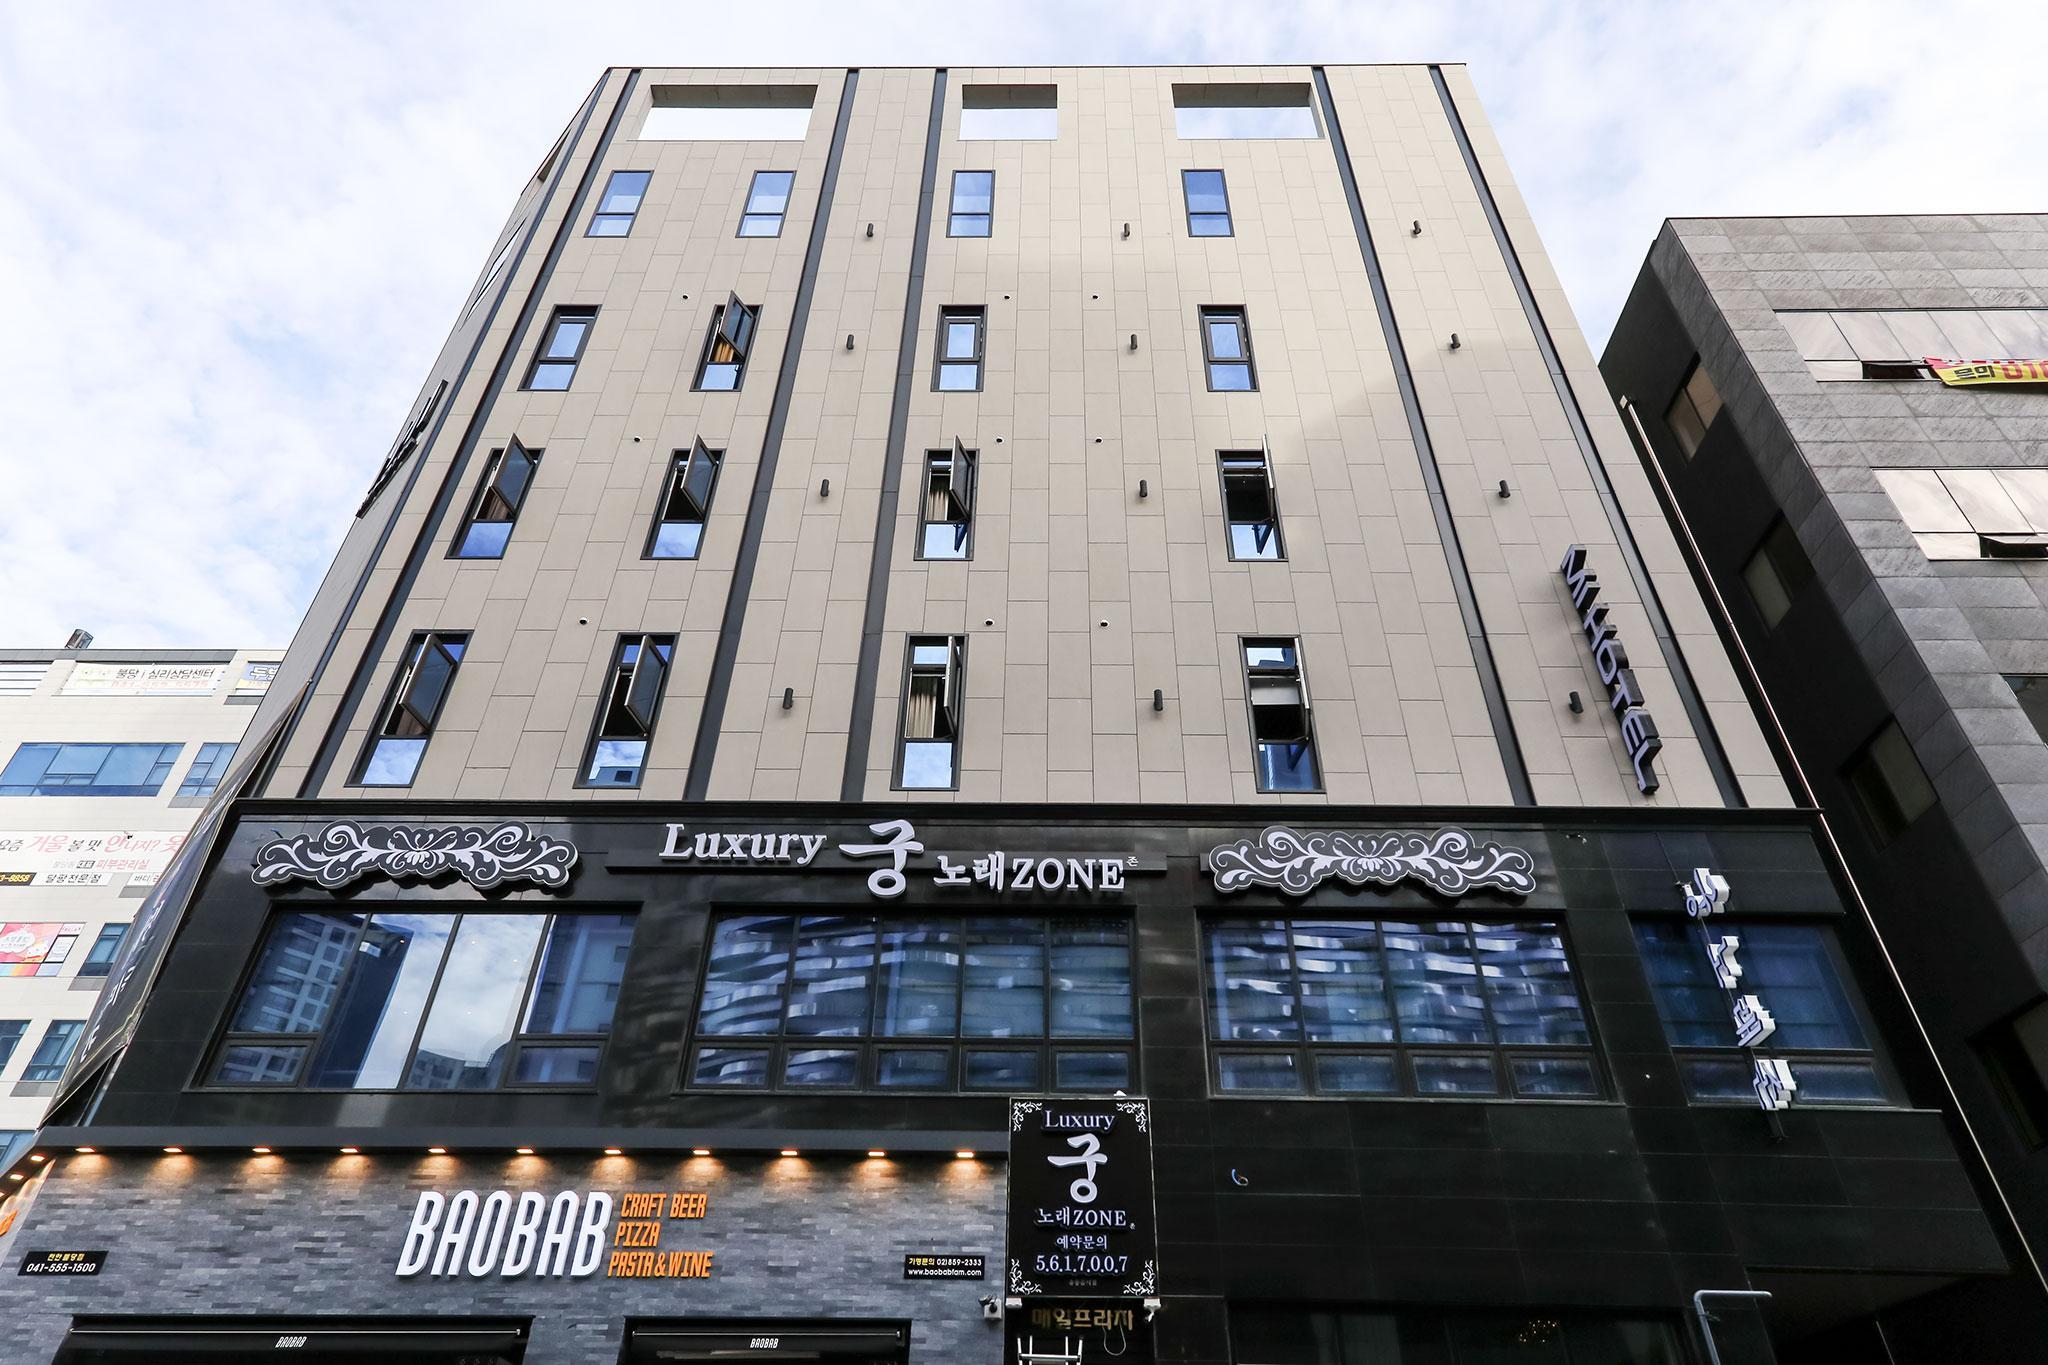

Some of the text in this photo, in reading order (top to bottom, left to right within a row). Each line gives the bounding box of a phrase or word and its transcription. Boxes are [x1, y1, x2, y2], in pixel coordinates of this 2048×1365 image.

[95, 859, 150, 871] 피부관리실
[658, 823, 828, 865] Luxury
[838, 818, 925, 898] 궁
[1043, 1110, 1116, 1131] Luxury
[1047, 1133, 1108, 1203] 궁
[621, 1193, 708, 1218] CRAFT BEER
[395, 1190, 614, 1277] BAOBAB
[614, 1221, 661, 1247] PIZZA
[1055, 1235, 1108, 1250] 예약문의
[26, 1263, 97, 1273] 041-555-1500
[907, 1268, 982, 1276] www.baobabfam.com
[274, 1336, 307, 1348] BAOBAB
[749, 1338, 779, 1349] BAOBAB
